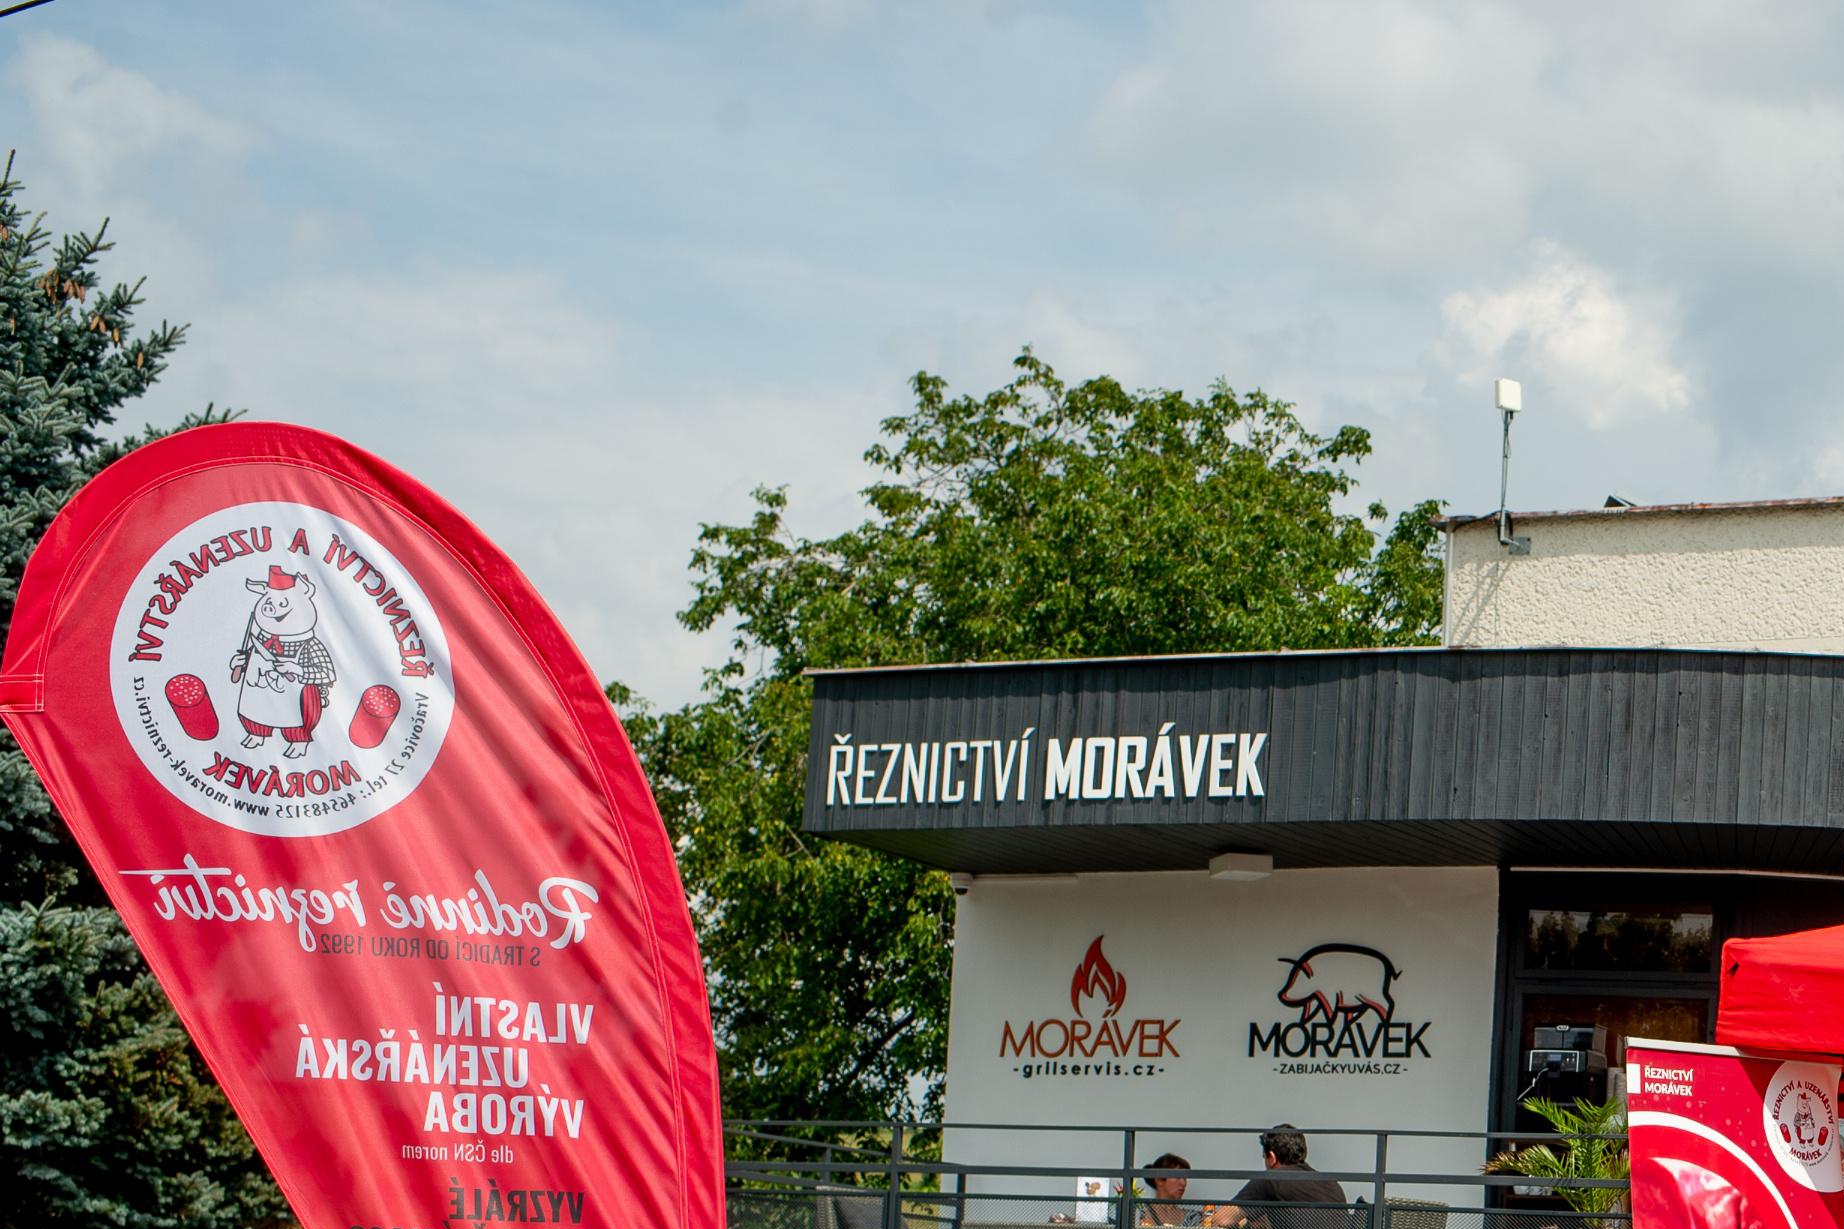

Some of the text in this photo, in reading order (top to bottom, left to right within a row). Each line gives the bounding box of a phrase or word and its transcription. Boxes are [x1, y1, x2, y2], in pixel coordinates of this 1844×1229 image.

[826, 721, 1268, 806] ŘEZNICTVÍ MORÁVEK
[999, 1008, 1181, 1058] MORÁVEK
[1644, 1065, 1694, 1082] ŘEZNICTVÍ
[1645, 1082, 1692, 1096] MORÁVEK
[1789, 1147, 1822, 1161] MORÁVEK
